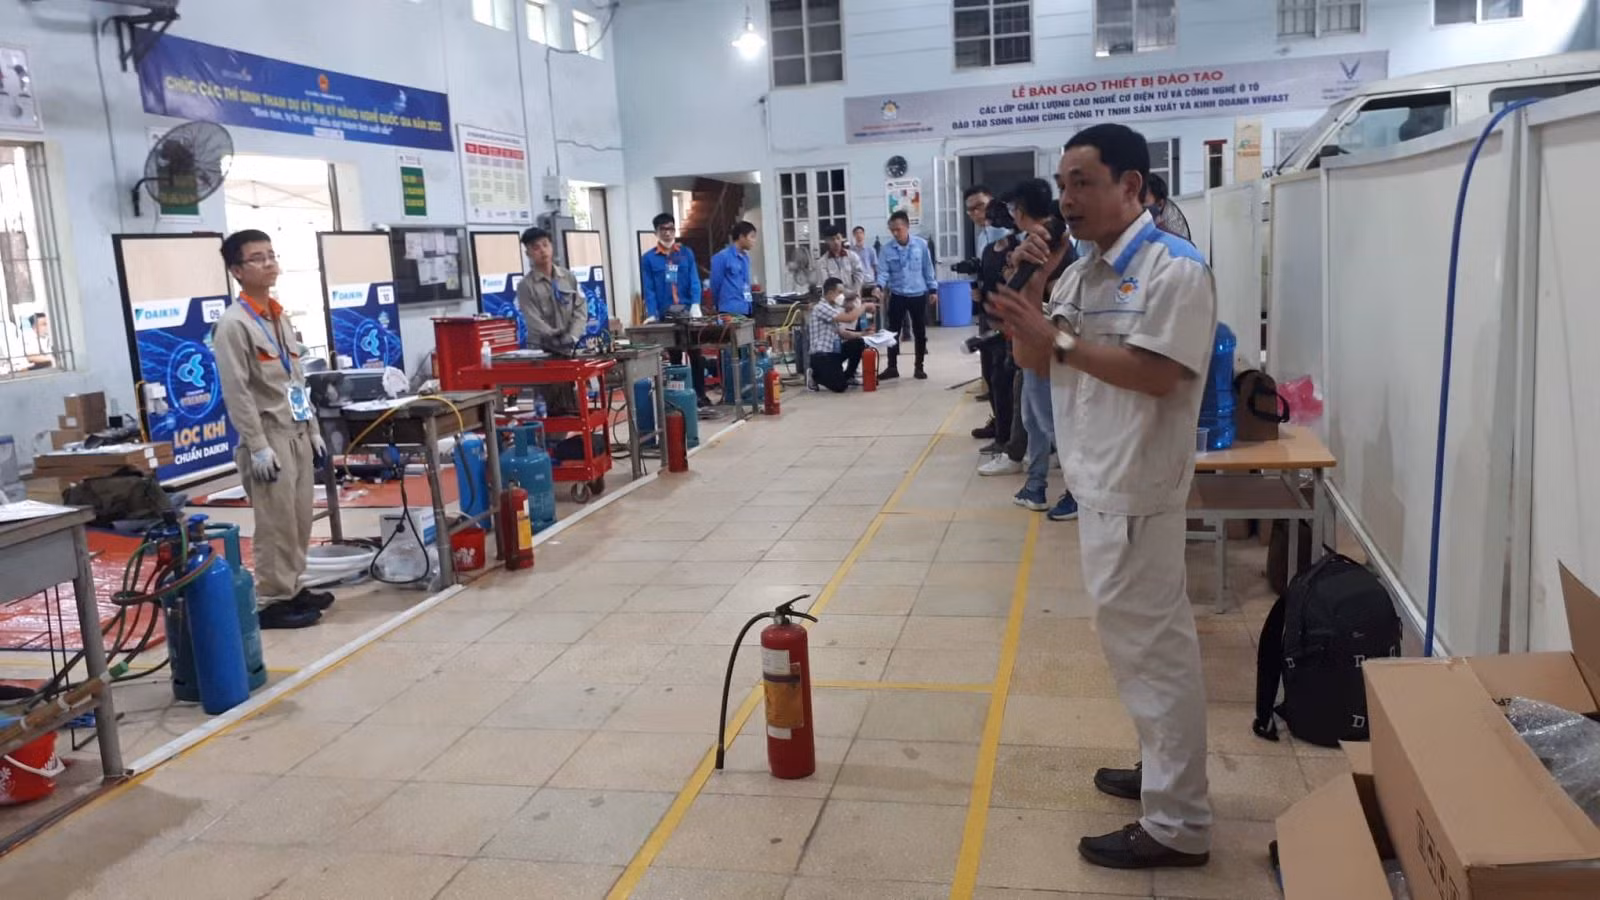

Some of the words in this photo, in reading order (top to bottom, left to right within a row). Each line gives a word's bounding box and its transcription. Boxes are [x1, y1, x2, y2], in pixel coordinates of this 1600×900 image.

[1029, 84, 1057, 97] BÀN
[1060, 82, 1097, 94] GIAO
[1101, 78, 1137, 90] THIẾT
[1141, 76, 1154, 88] BỊ
[1157, 72, 1190, 85] ĐÀO
[1193, 71, 1224, 84] TẠO
[1073, 98, 1090, 106] CAO
[1184, 86, 1210, 96] CÔNG
[990, 118, 1013, 126] SONG
[1016, 114, 1040, 124] HÀNH
[1068, 110, 1092, 119] CÔNG
[1095, 108, 1104, 117] TY
[1108, 106, 1130, 116] TNHH
[1194, 100, 1216, 109] KINH
[1218, 97, 1249, 107] DOANH
[1252, 94, 1289, 104] VINFAST
[144, 308, 180, 320] DAIKIN
[210, 309, 220, 320] 09
[174, 430, 200, 450] LỌC
[203, 416, 226, 440] KHÍ
[175, 447, 202, 464] CHUẨN
[205, 443, 229, 458] DAIKIN
